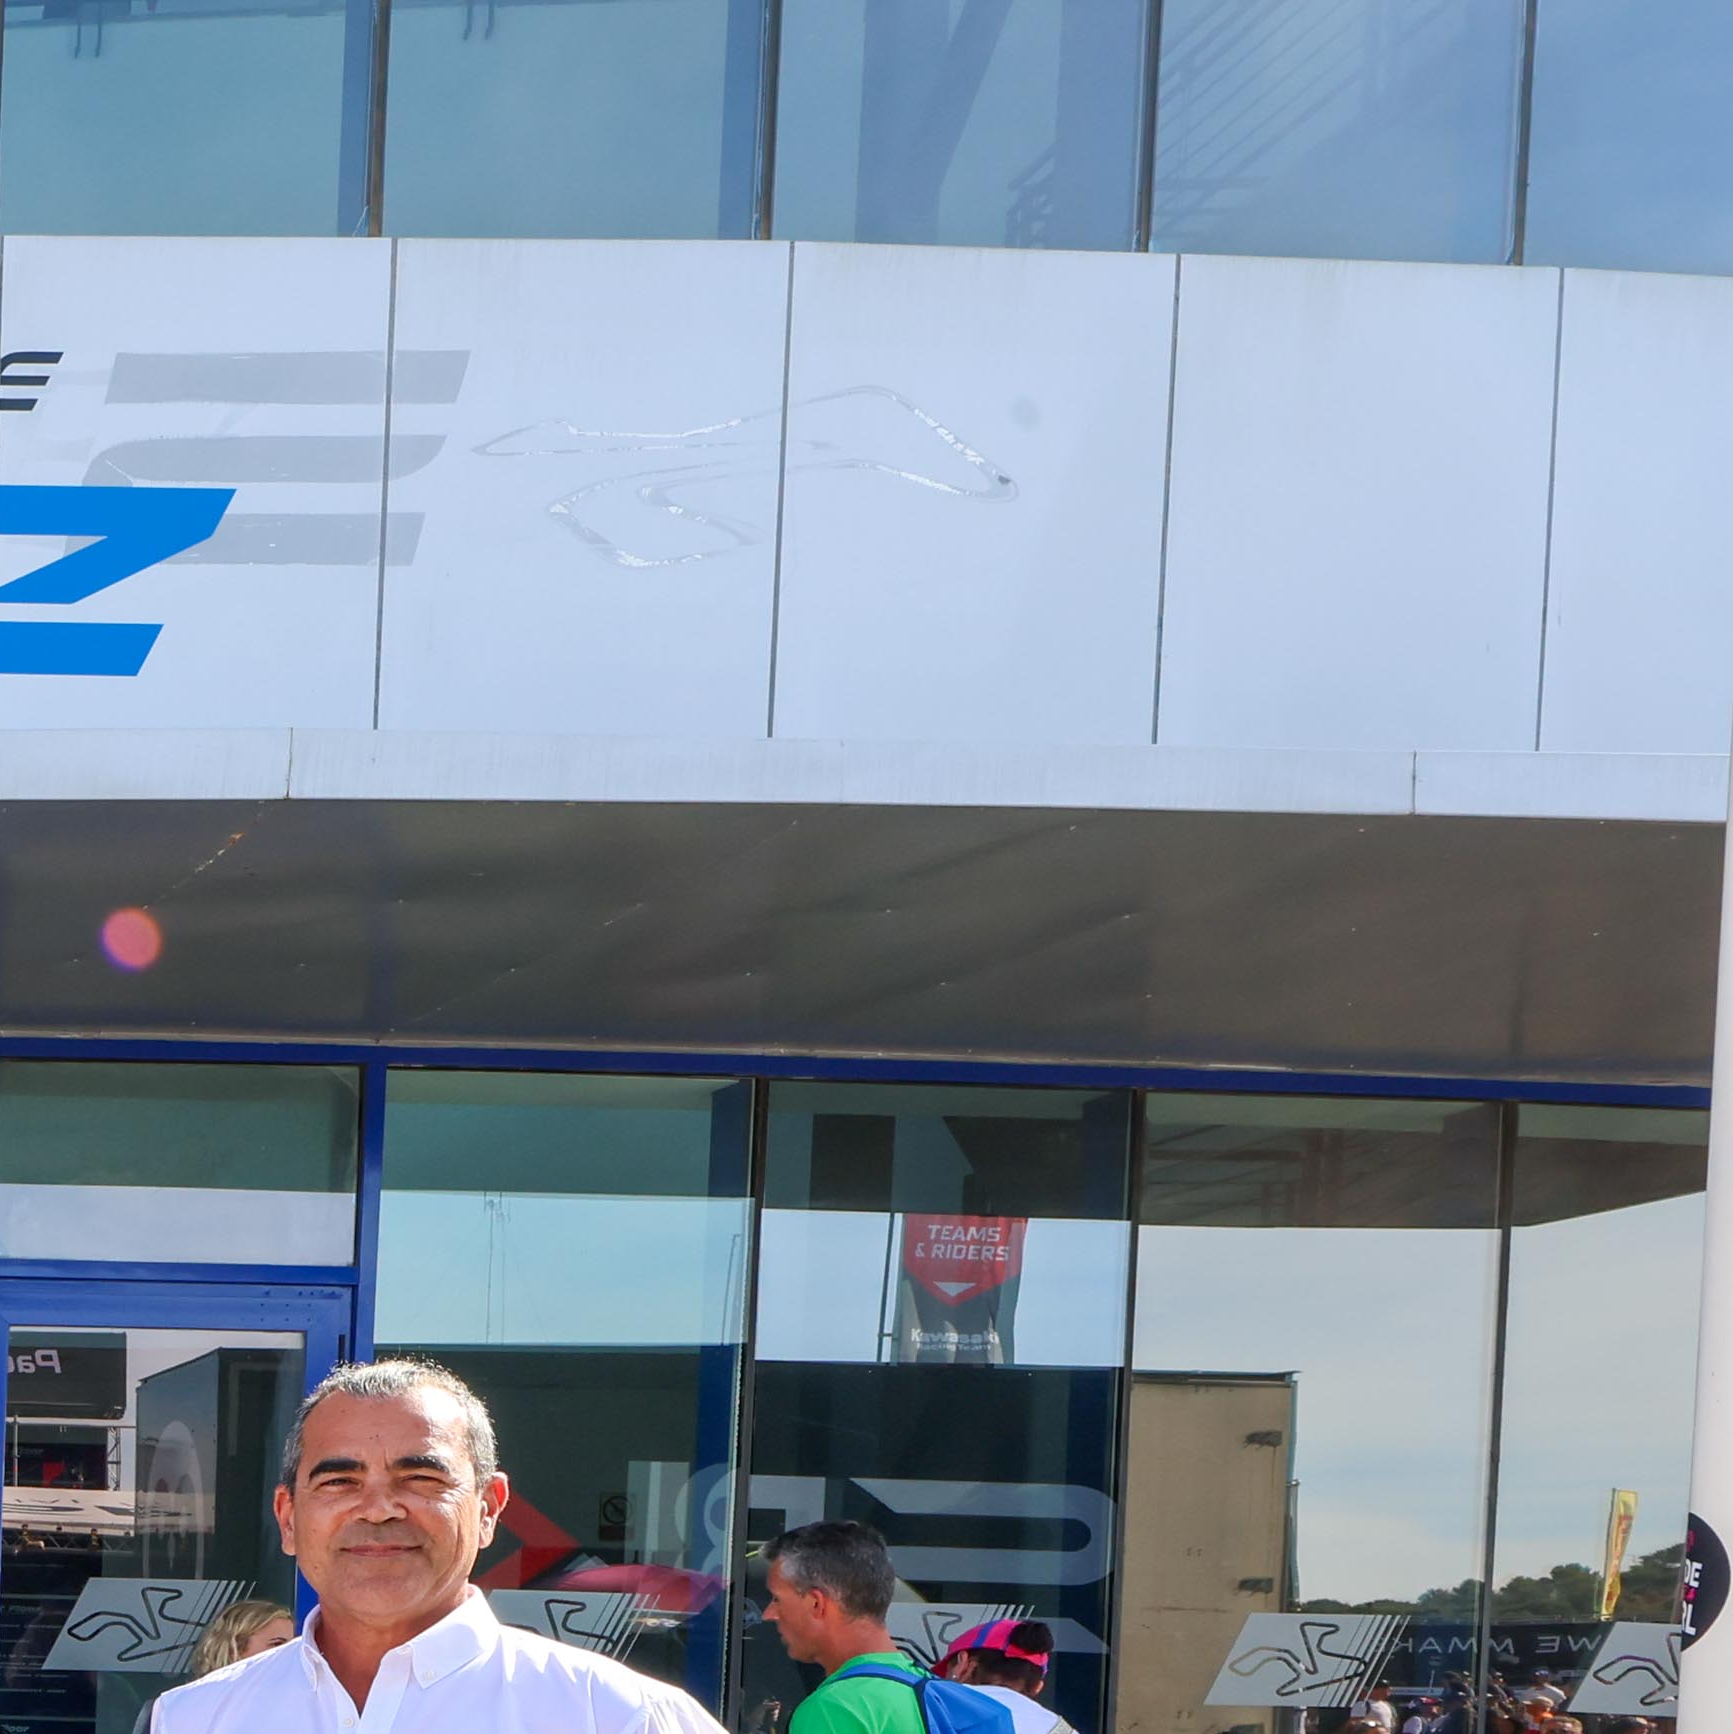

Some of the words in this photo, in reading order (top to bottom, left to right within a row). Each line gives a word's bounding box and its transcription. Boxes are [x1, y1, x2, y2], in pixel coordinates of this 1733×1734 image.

[928, 1224, 1002, 1242] TEAMS
[914, 1243, 926, 1258] &
[932, 1244, 1009, 1261] RIDERS
[911, 1328, 1000, 1344] Kawasaki
